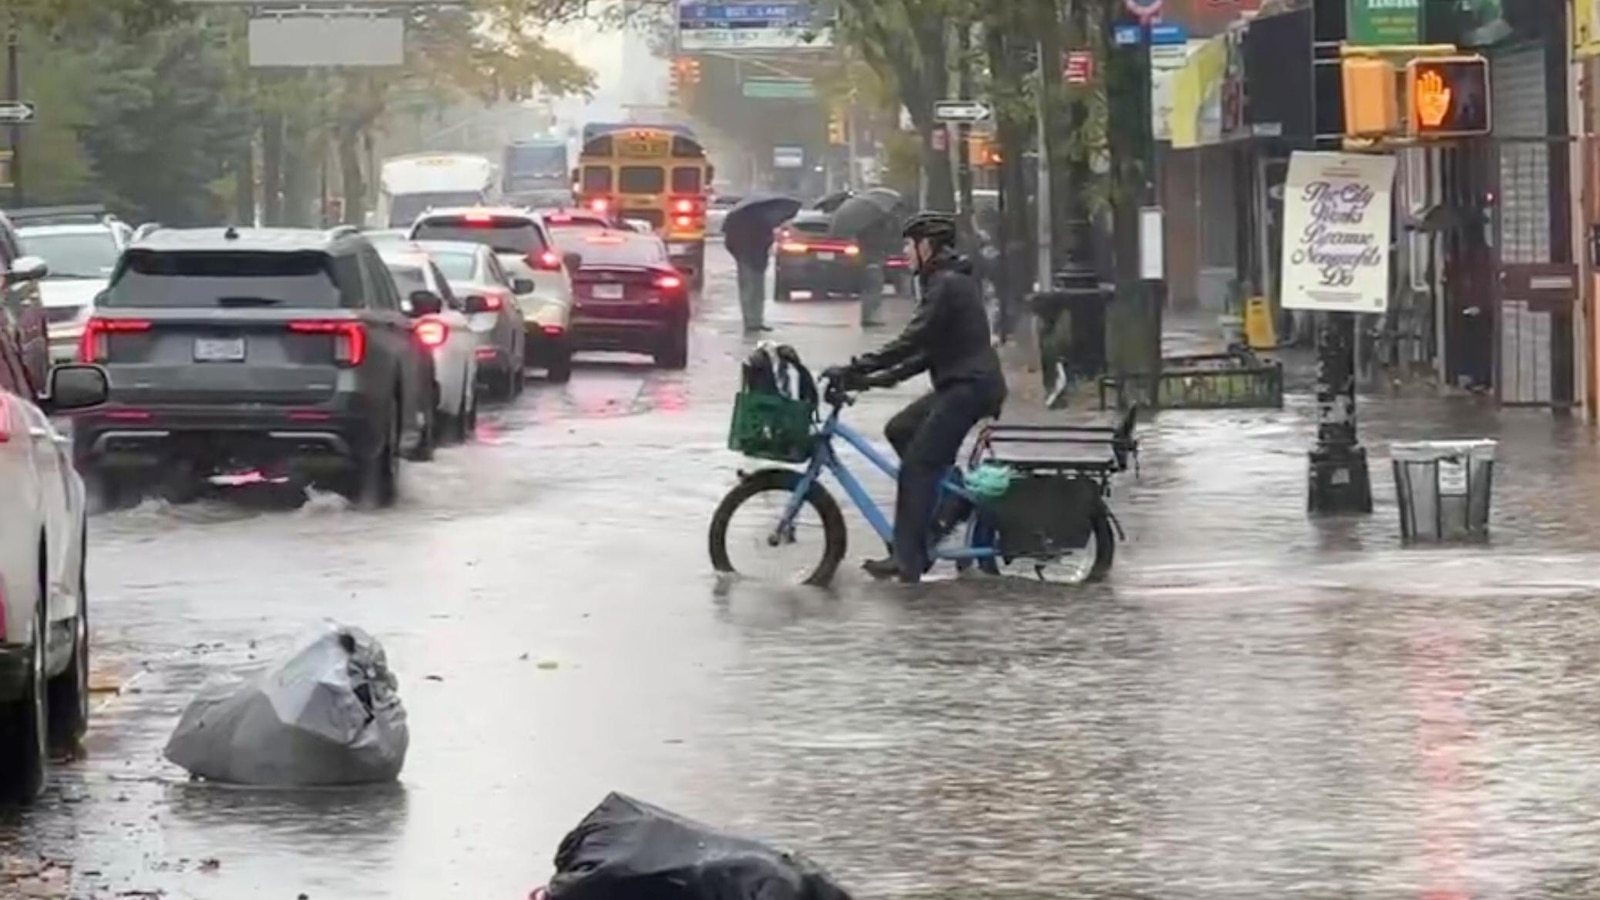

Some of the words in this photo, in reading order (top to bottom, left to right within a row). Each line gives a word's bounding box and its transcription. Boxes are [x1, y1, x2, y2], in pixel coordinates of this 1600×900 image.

[1301, 181, 1336, 202] The
[1341, 183, 1375, 208] City
[1311, 201, 1363, 223] Works
[1300, 223, 1374, 245] Because
[1291, 246, 1382, 270] Nonprofits
[1318, 265, 1354, 286] Do
